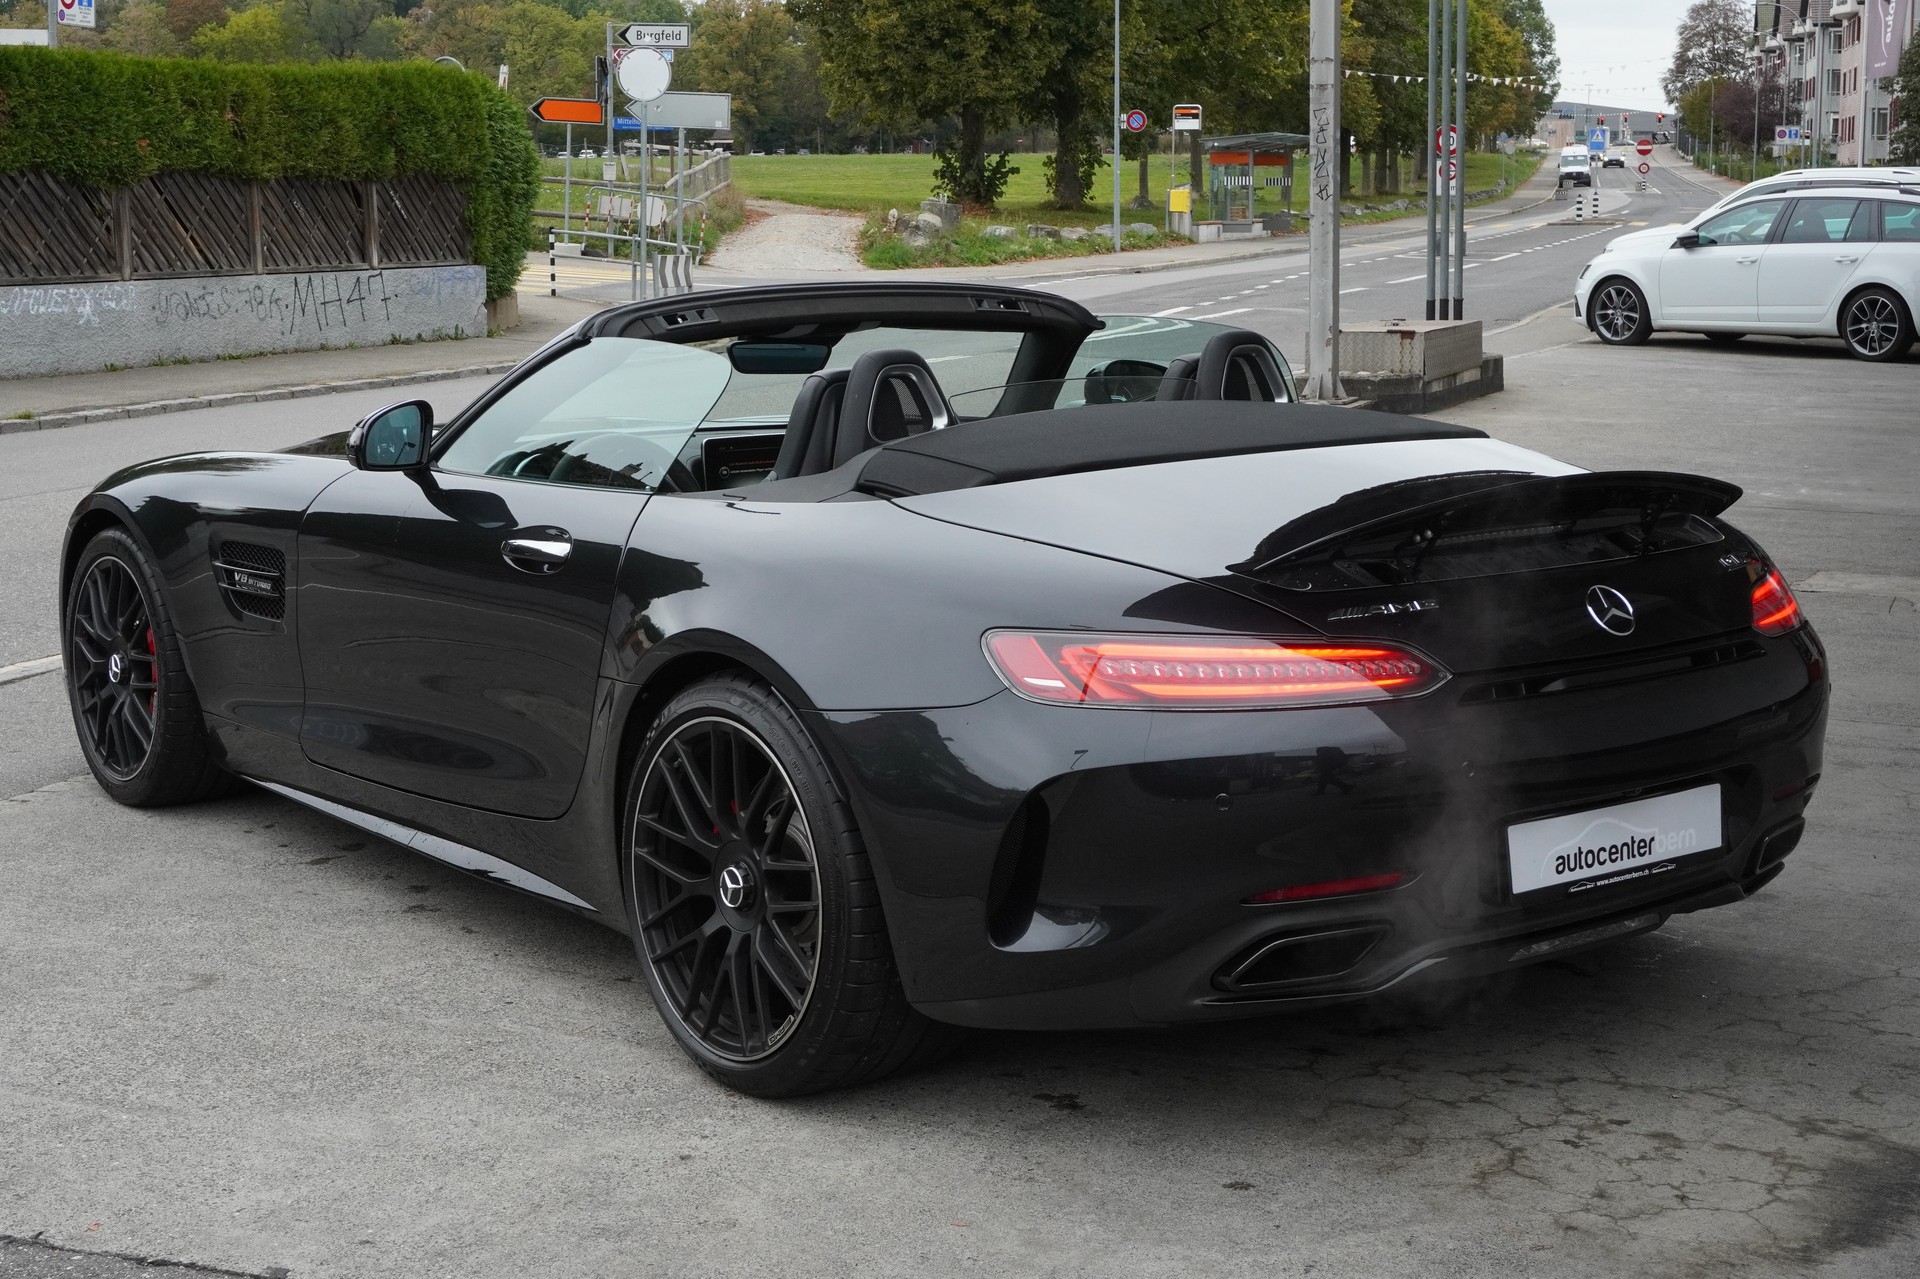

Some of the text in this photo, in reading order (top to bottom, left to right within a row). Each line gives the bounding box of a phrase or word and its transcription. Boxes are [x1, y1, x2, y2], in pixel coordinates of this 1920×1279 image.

[1885, 0, 1896, 43] auto
[234, 571, 248, 583] V8
[1596, 869, 1650, 887] www.autocenterbern.ch
